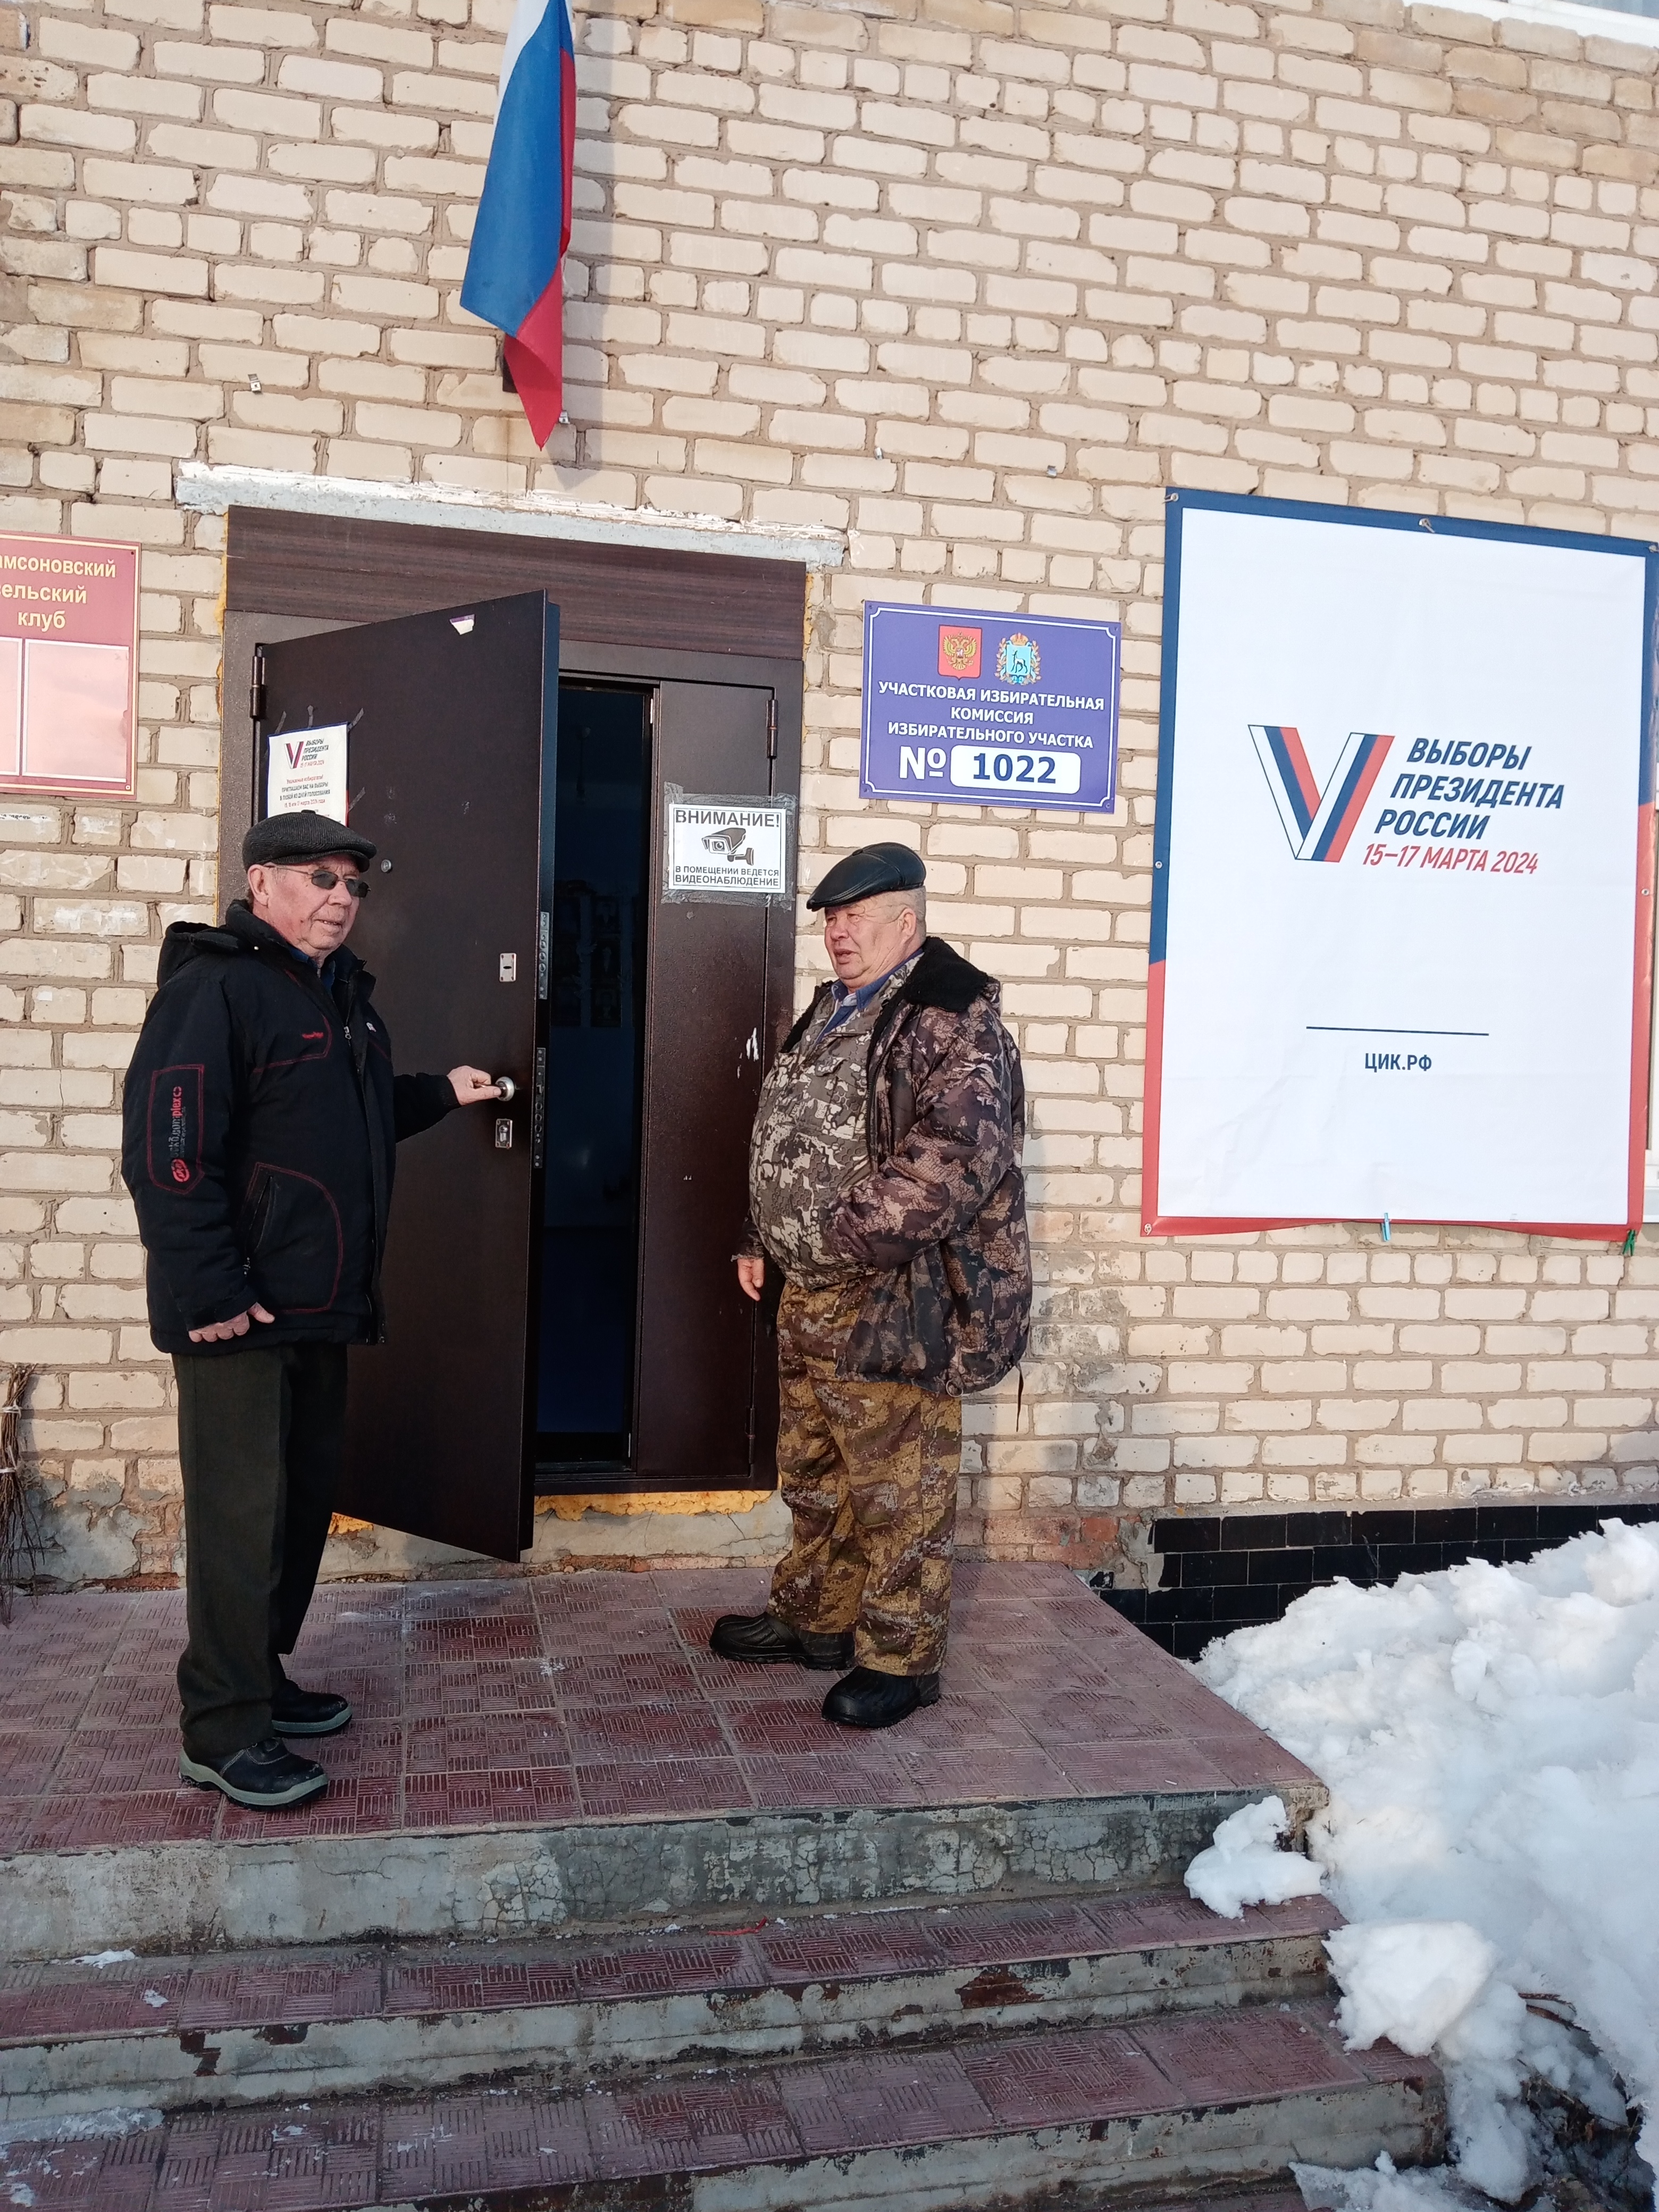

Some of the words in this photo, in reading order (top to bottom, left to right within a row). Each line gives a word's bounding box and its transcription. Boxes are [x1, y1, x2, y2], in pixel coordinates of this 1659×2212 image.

[0, 555, 116, 578] мсоновский
[0, 584, 87, 604] ельский
[18, 610, 66, 632] клуб
[878, 681, 976, 701] УЧАСТКОВАЯ
[980, 689, 1104, 710] ИЗБИРАТЕЛЬНАЯ
[951, 707, 1034, 725] КОМИССИЯ
[888, 722, 1025, 744] ИЗБИРАТЕЛЬНОГО
[1028, 733, 1094, 748] УЧАСТКА
[1406, 738, 1532, 770] ВЫБОРЫ
[973, 752, 1057, 784] 1022
[1390, 774, 1565, 809] ПРЕЗИДЕНТА
[675, 809, 780, 827] ВНИМАНИЕ!
[1374, 809, 1491, 840] РОССИИ
[684, 866, 739, 875] ПОМЕЩЕНИИ
[1420, 846, 1486, 872] МАРТА
[1490, 851, 1539, 874] 2024
[675, 875, 779, 887] ВИДЕОНАБЛЮДЕНИЕ
[1364, 1052, 1432, 1073] ЦИК.РФ
